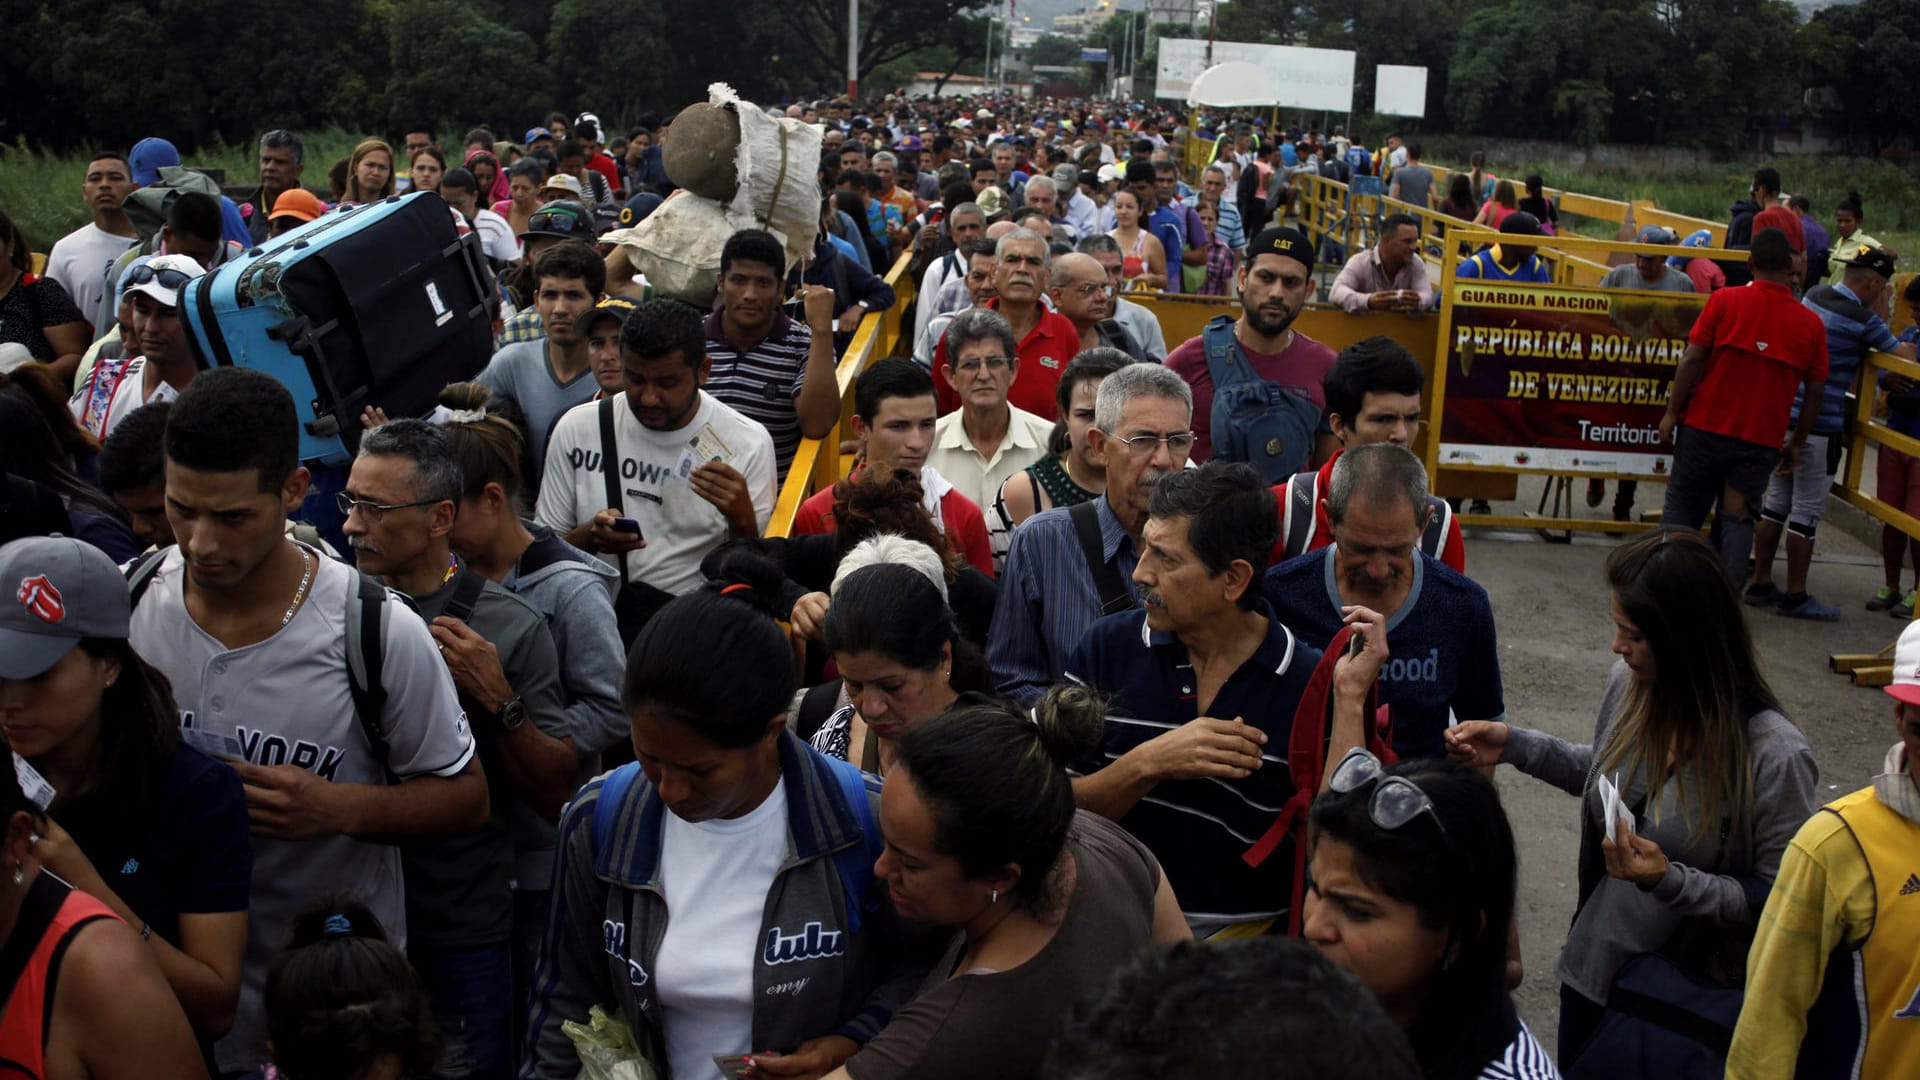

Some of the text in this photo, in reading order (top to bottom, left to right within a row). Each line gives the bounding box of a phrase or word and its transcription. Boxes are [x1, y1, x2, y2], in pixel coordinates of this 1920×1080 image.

[1273, 239, 1295, 250] CAT
[1461, 289, 1610, 312] GUARDIA NACION
[1456, 319, 1584, 359] REPÚBLICA
[1507, 370, 1541, 399] DE
